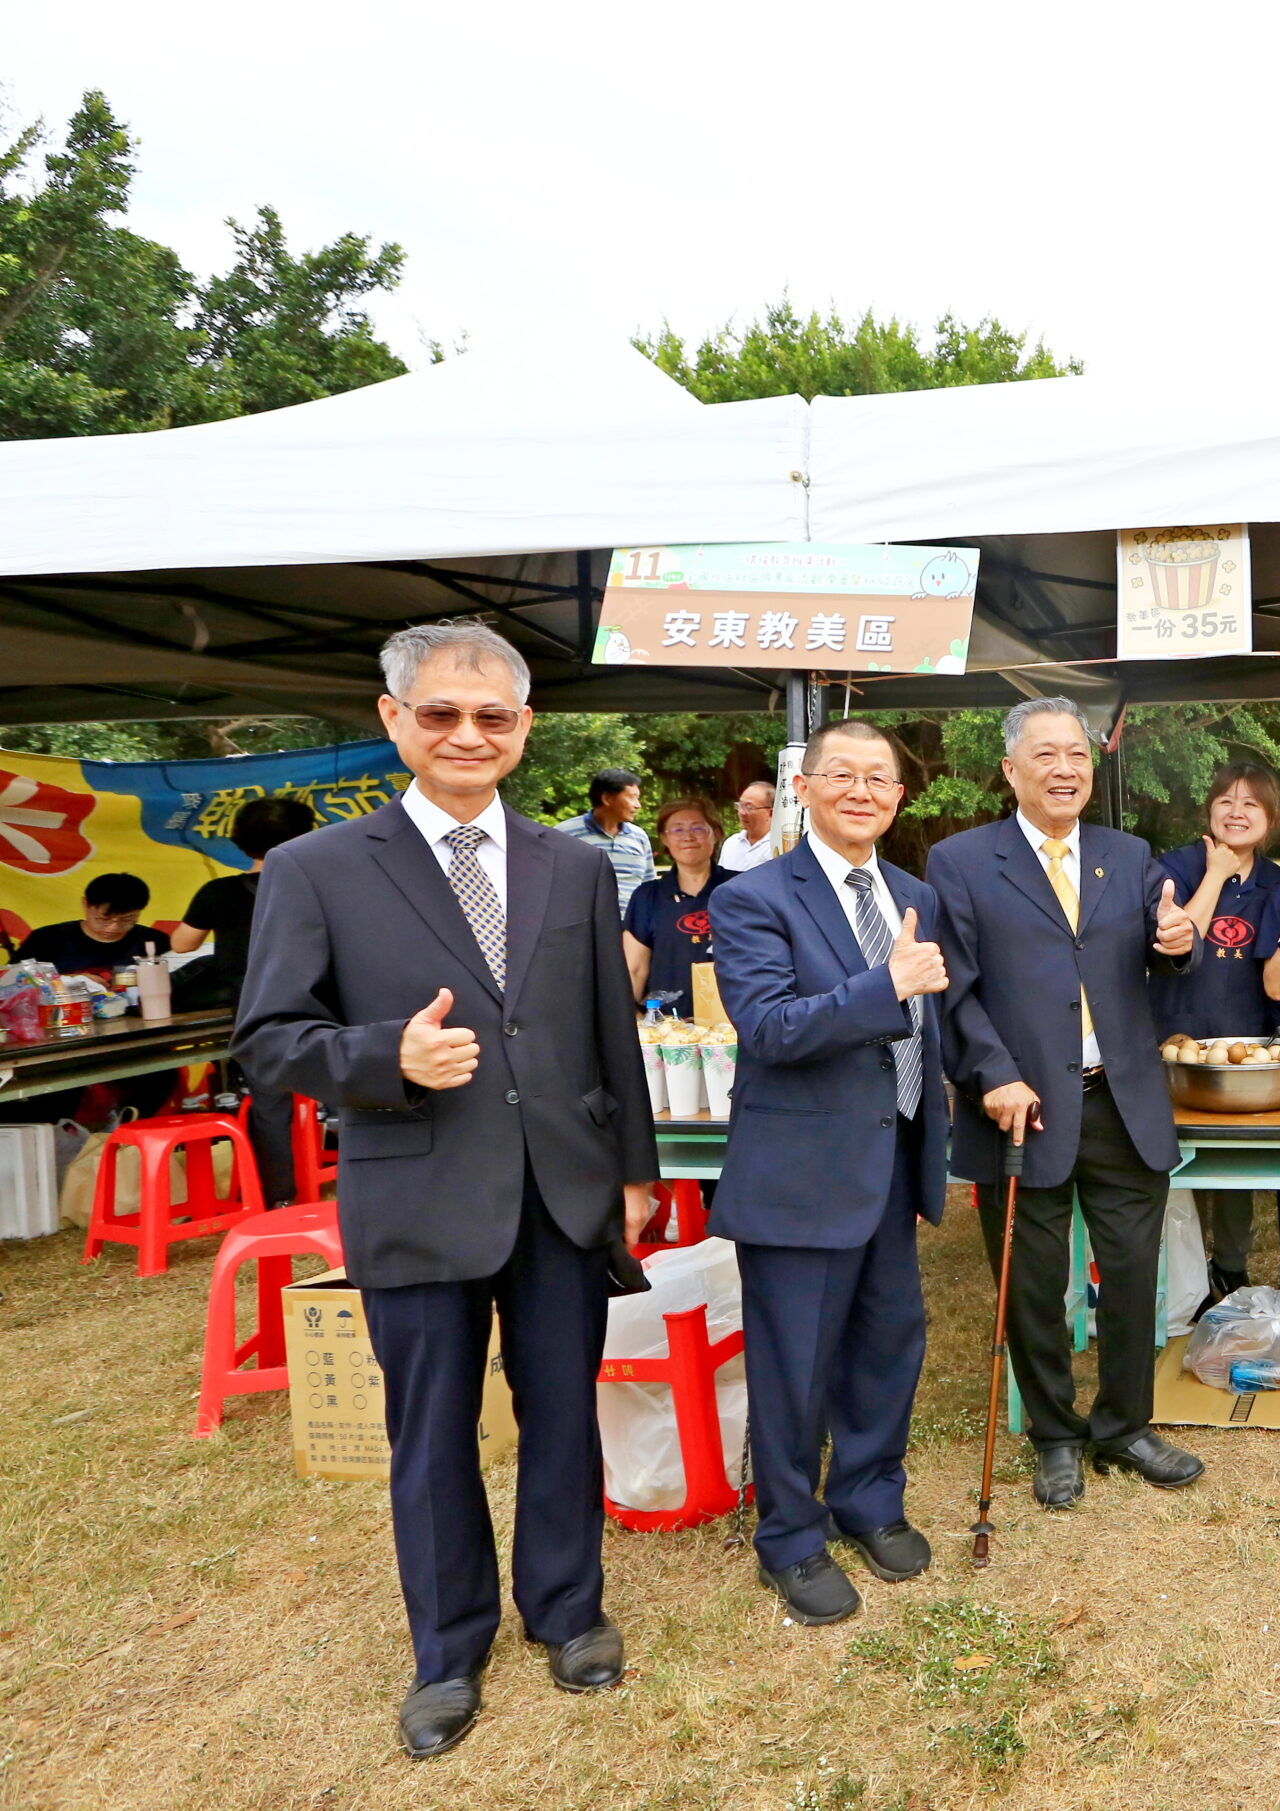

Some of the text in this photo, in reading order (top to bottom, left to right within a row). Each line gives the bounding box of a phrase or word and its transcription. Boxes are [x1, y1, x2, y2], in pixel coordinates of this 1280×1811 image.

[625, 551, 661, 581] 11
[661, 609, 897, 653] 安東教美區
[324, 1373, 336, 1387] 黃
[326, 1394, 339, 1408] 黑
